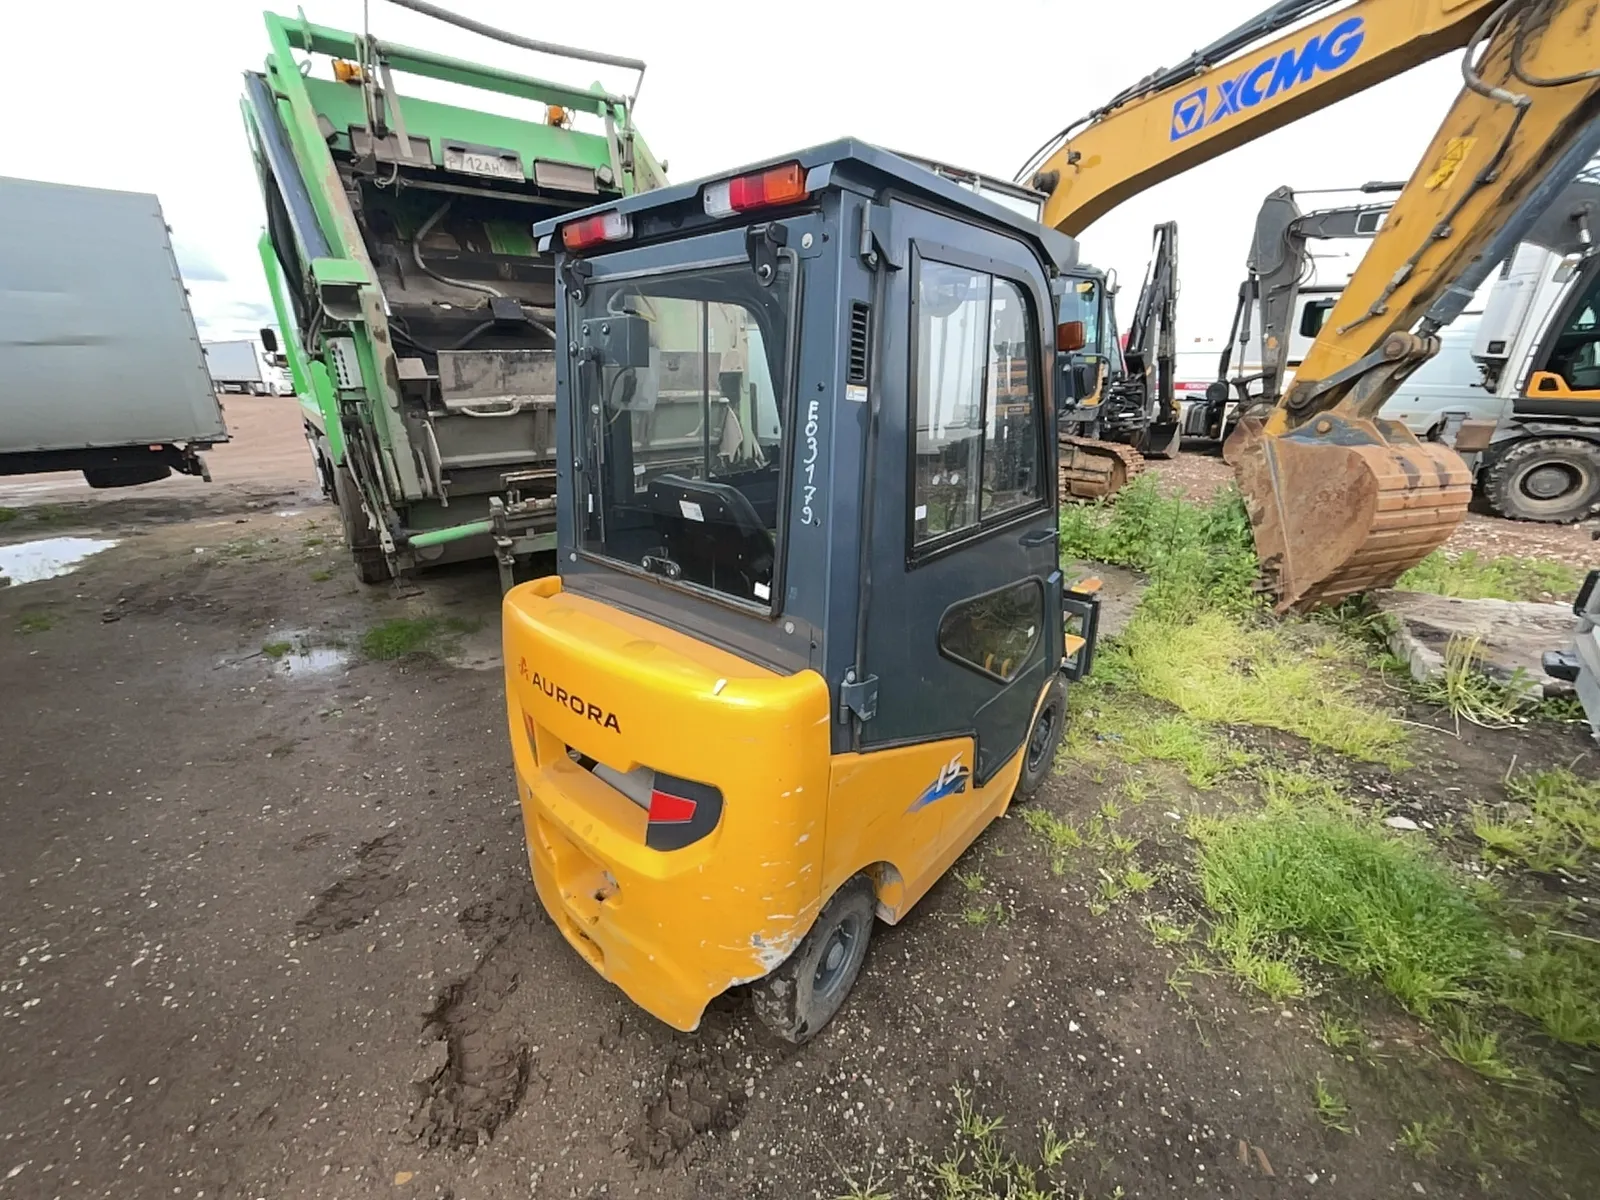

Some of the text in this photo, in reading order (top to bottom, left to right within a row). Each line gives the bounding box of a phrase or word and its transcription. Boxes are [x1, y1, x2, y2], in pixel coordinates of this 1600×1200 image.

[1204, 16, 1366, 125] XCMG
[801, 400, 819, 525] E03179
[532, 672, 622, 734] AURORA
